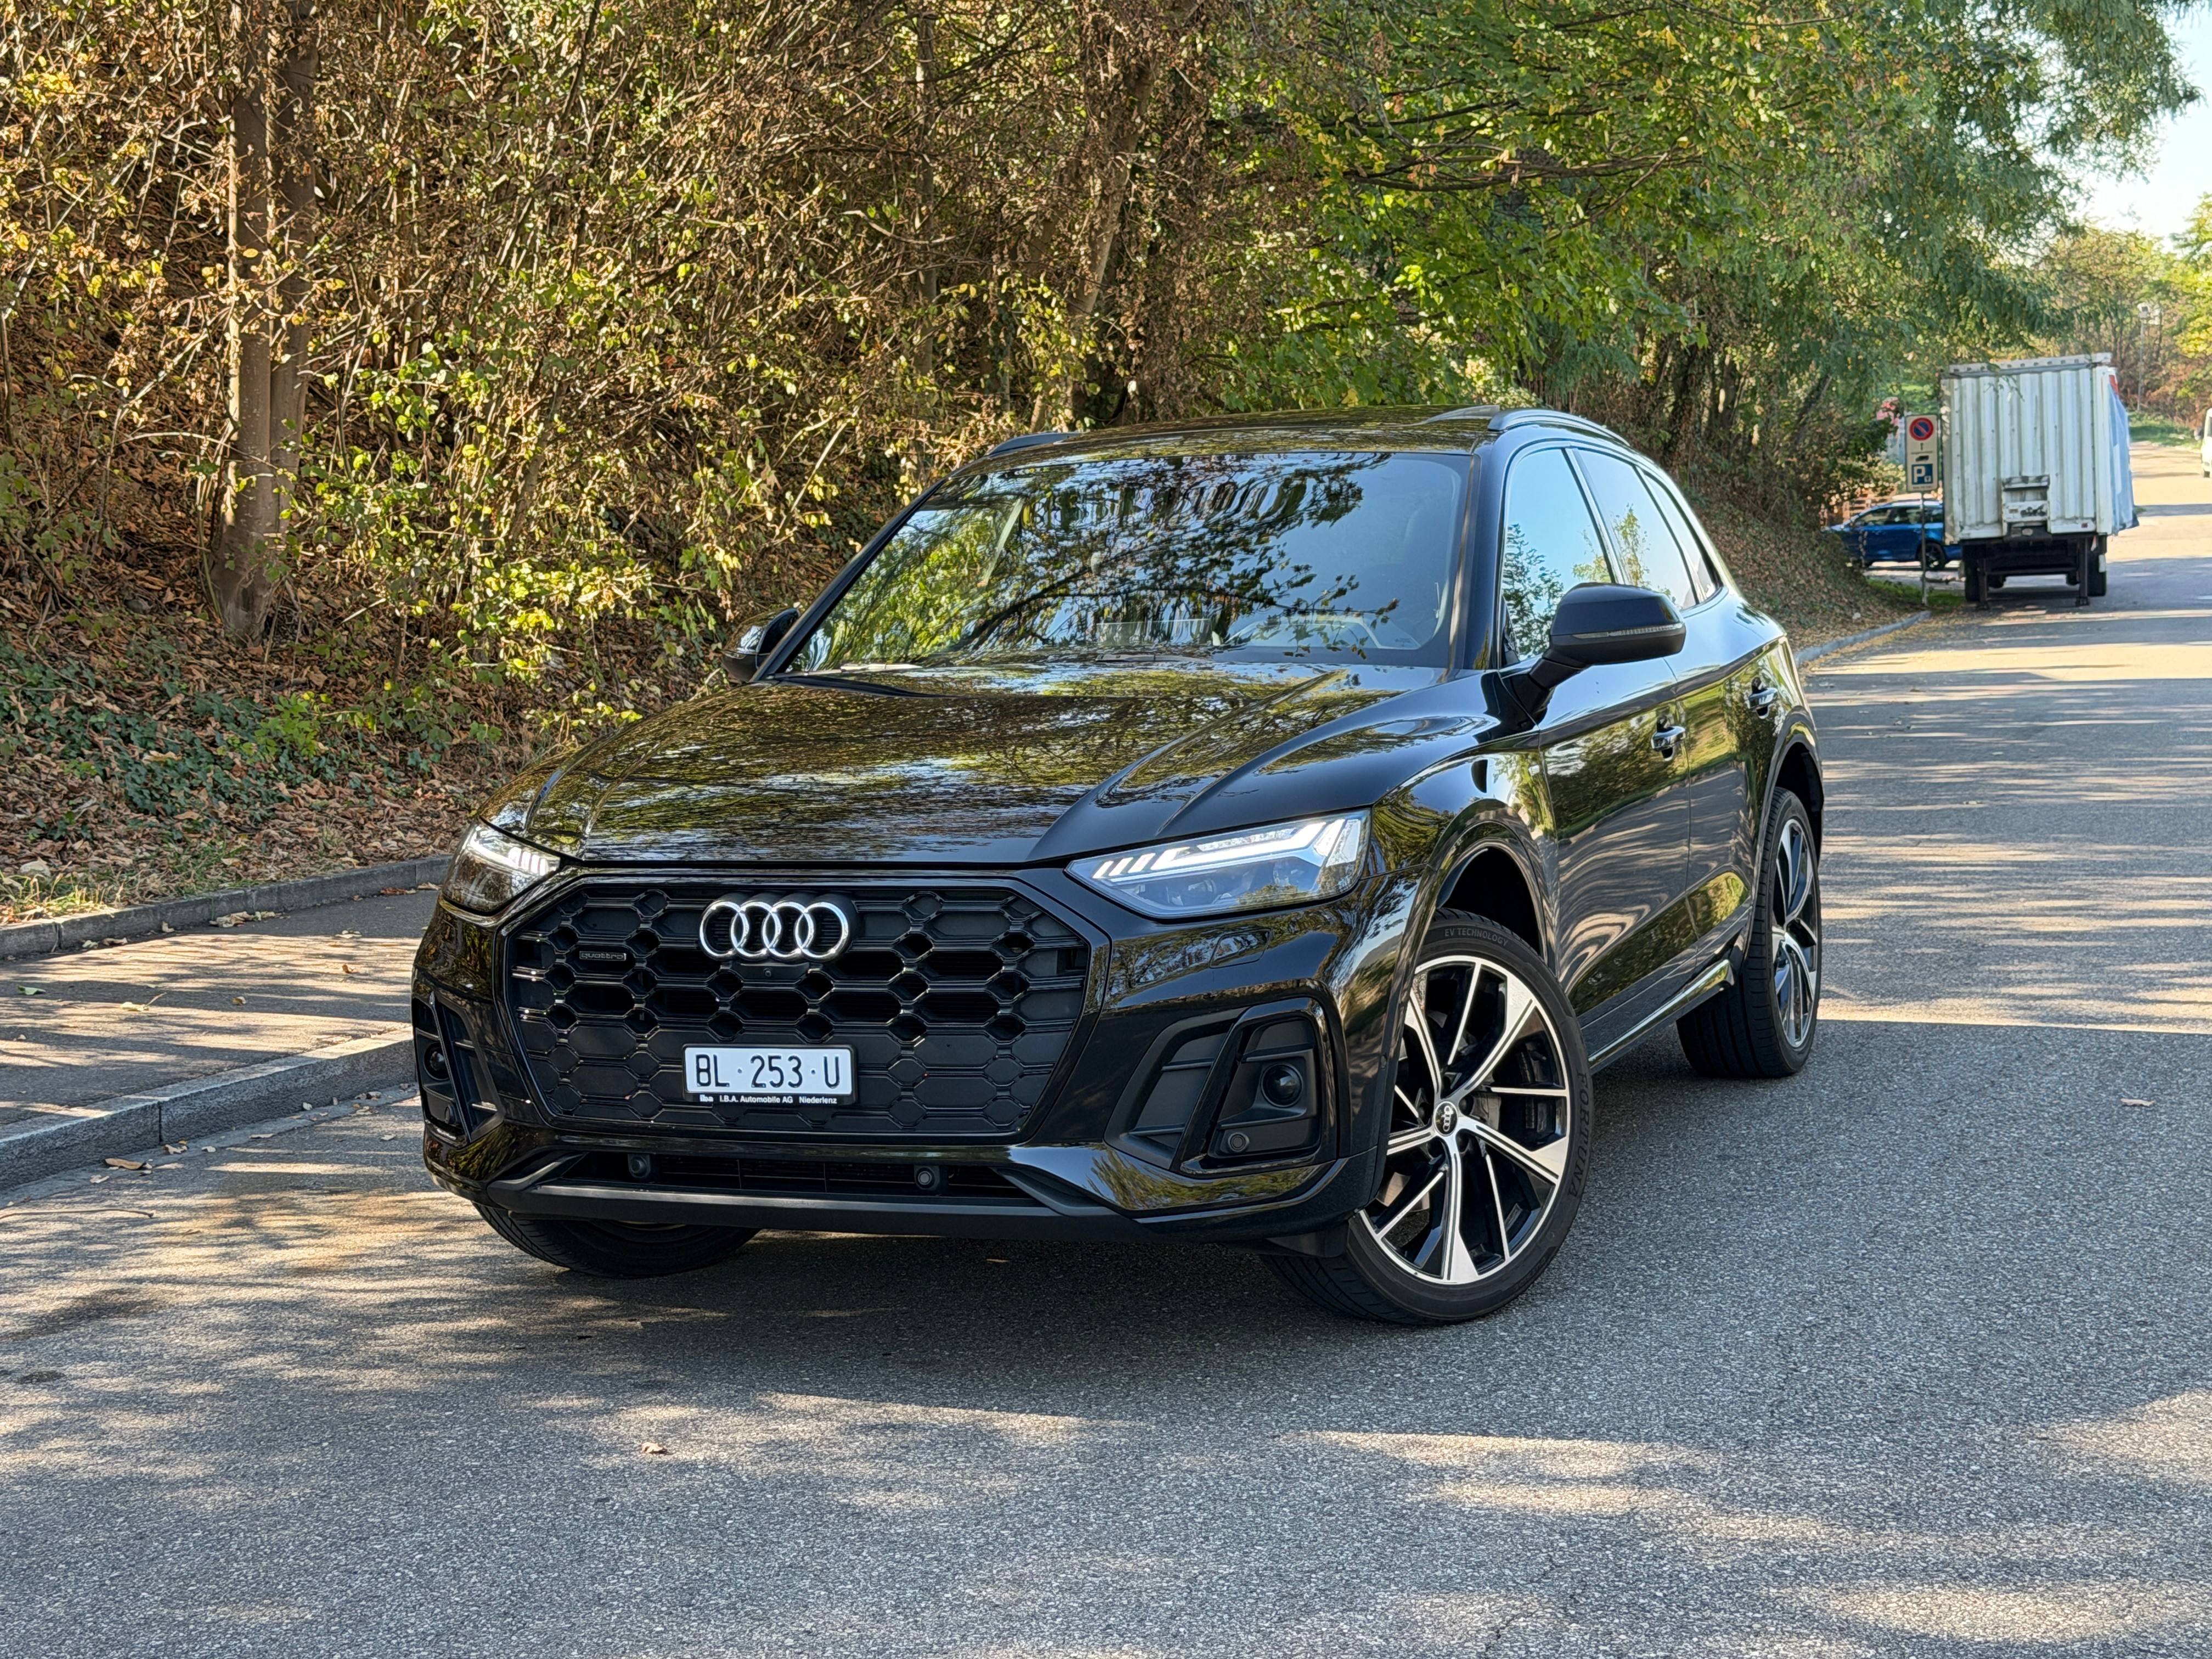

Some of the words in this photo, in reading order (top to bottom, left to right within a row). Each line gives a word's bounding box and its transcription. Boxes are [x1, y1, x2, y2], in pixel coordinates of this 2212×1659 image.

[1914, 466, 1926, 483] P
[1444, 928, 1454, 936] EV
[1457, 928, 1508, 946] TECHNOLOGY
[696, 1054, 730, 1087] BL
[750, 1054, 803, 1088] 253
[823, 1056, 840, 1089] U
[740, 1095, 781, 1103] Automobile
[1568, 1069, 1590, 1198] FORTUNA
